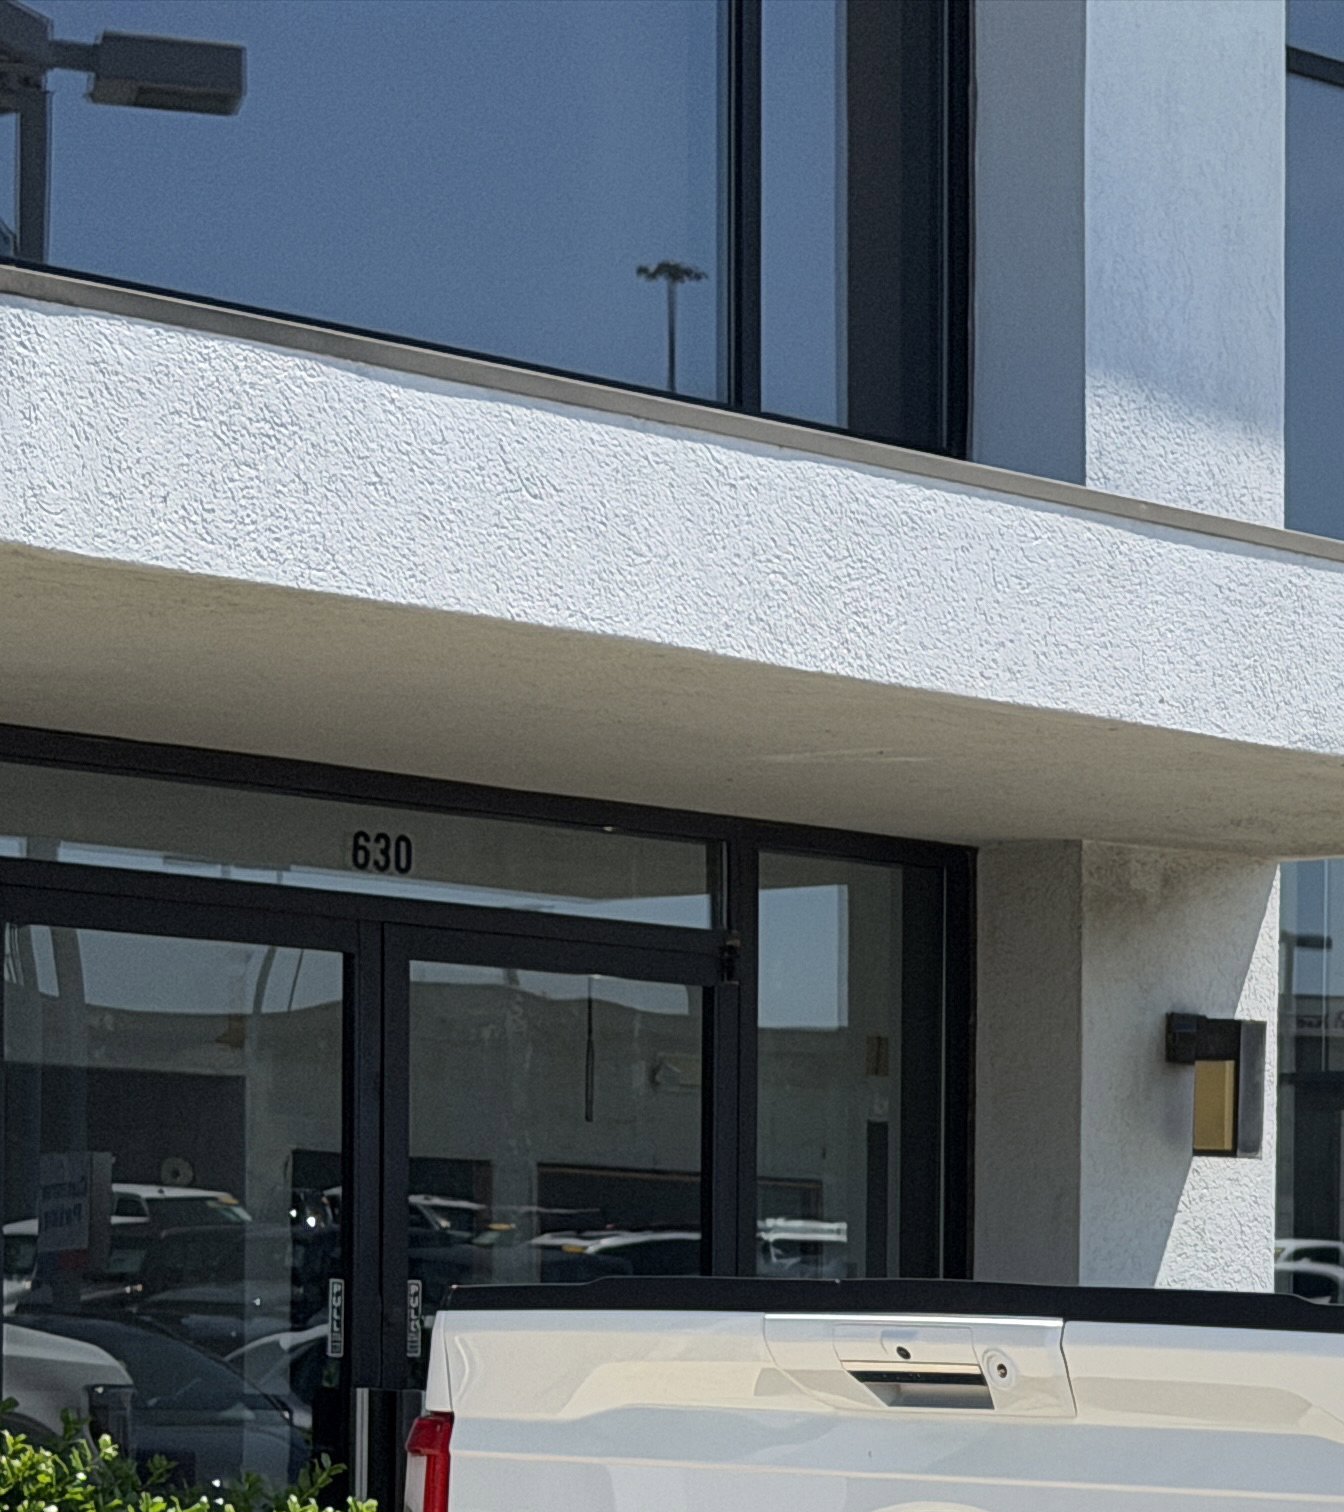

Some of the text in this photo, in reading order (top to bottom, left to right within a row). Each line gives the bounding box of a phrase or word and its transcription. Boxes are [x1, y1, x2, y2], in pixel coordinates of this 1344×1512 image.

[352, 830, 412, 874] 630
[332, 1283, 342, 1331] PULL
[410, 1284, 419, 1331] PULL
